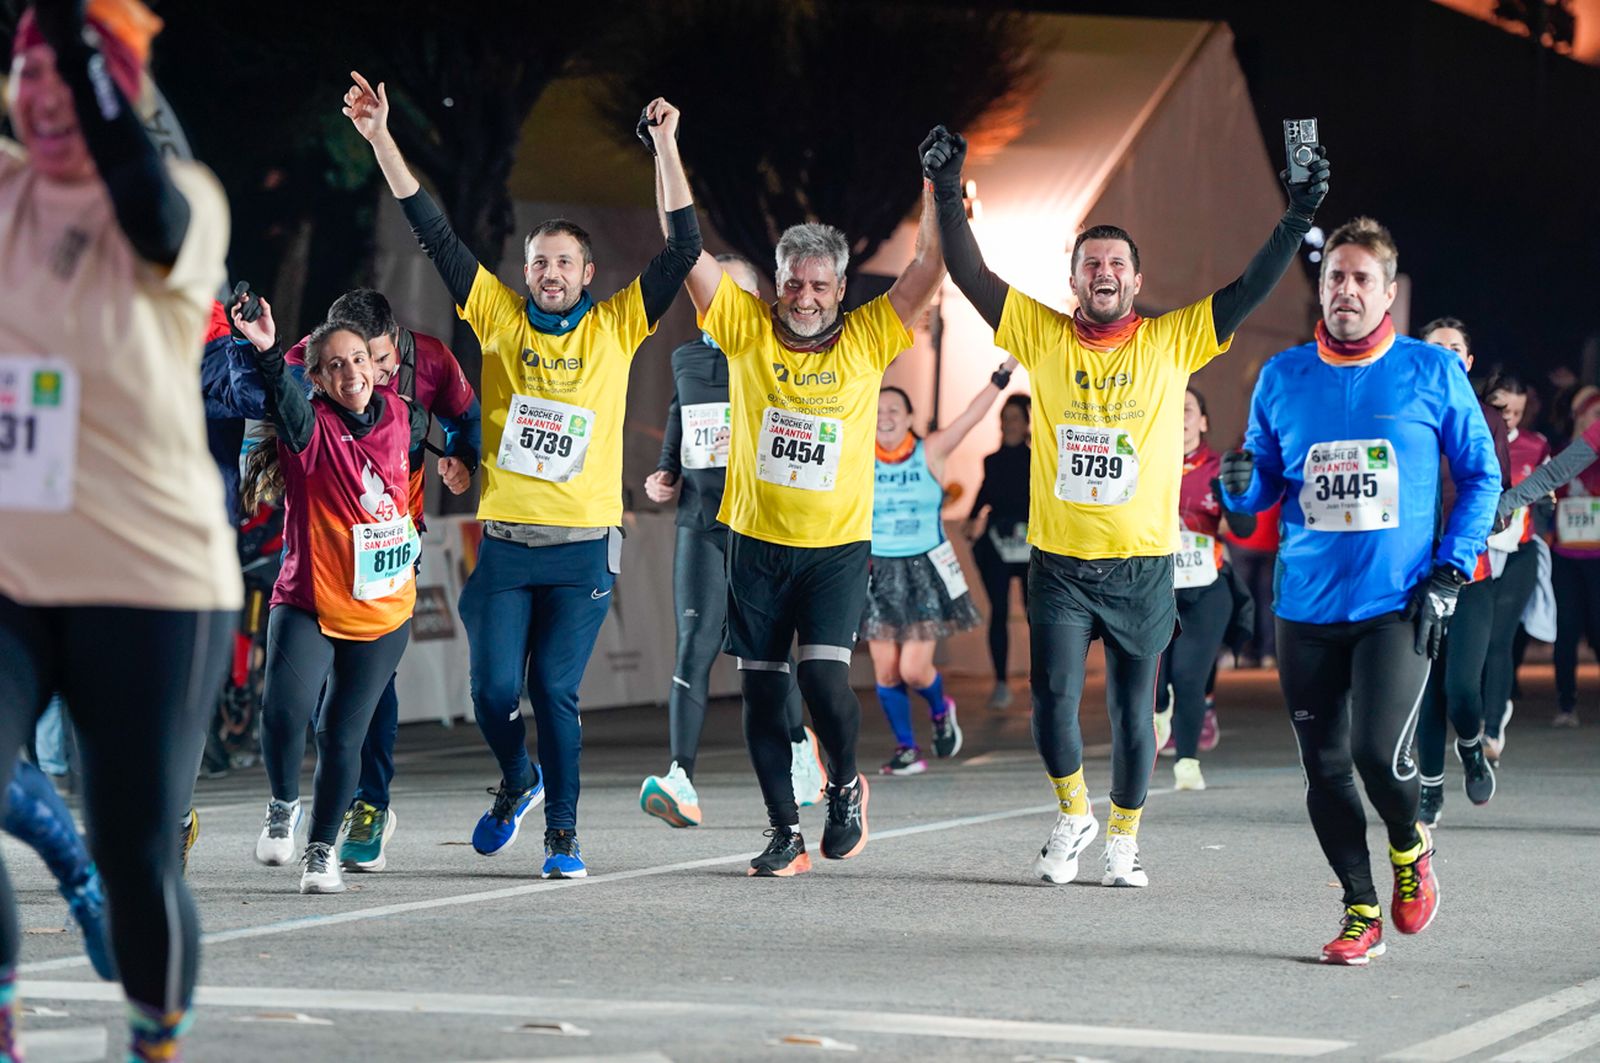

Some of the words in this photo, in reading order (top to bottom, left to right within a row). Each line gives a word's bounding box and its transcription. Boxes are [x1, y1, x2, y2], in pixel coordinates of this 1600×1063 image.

[516, 416, 533, 427] SAN
[527, 409, 553, 420] NOCHE
[553, 413, 564, 423] DE
[778, 418, 802, 429] NOCHE
[520, 427, 573, 458] 5739
[1066, 442, 1081, 451] SAN
[1074, 434, 1098, 444] NOCHE
[1099, 436, 1110, 445] DE
[771, 436, 826, 466] 6454
[1347, 450, 1358, 460] DE
[1071, 453, 1123, 479] 5739
[876, 470, 921, 485] erja
[1315, 473, 1378, 502] 3445
[375, 500, 394, 522] 43
[373, 528, 396, 539] NOCHE
[364, 540, 381, 550] SAN
[374, 542, 411, 573] 8116
